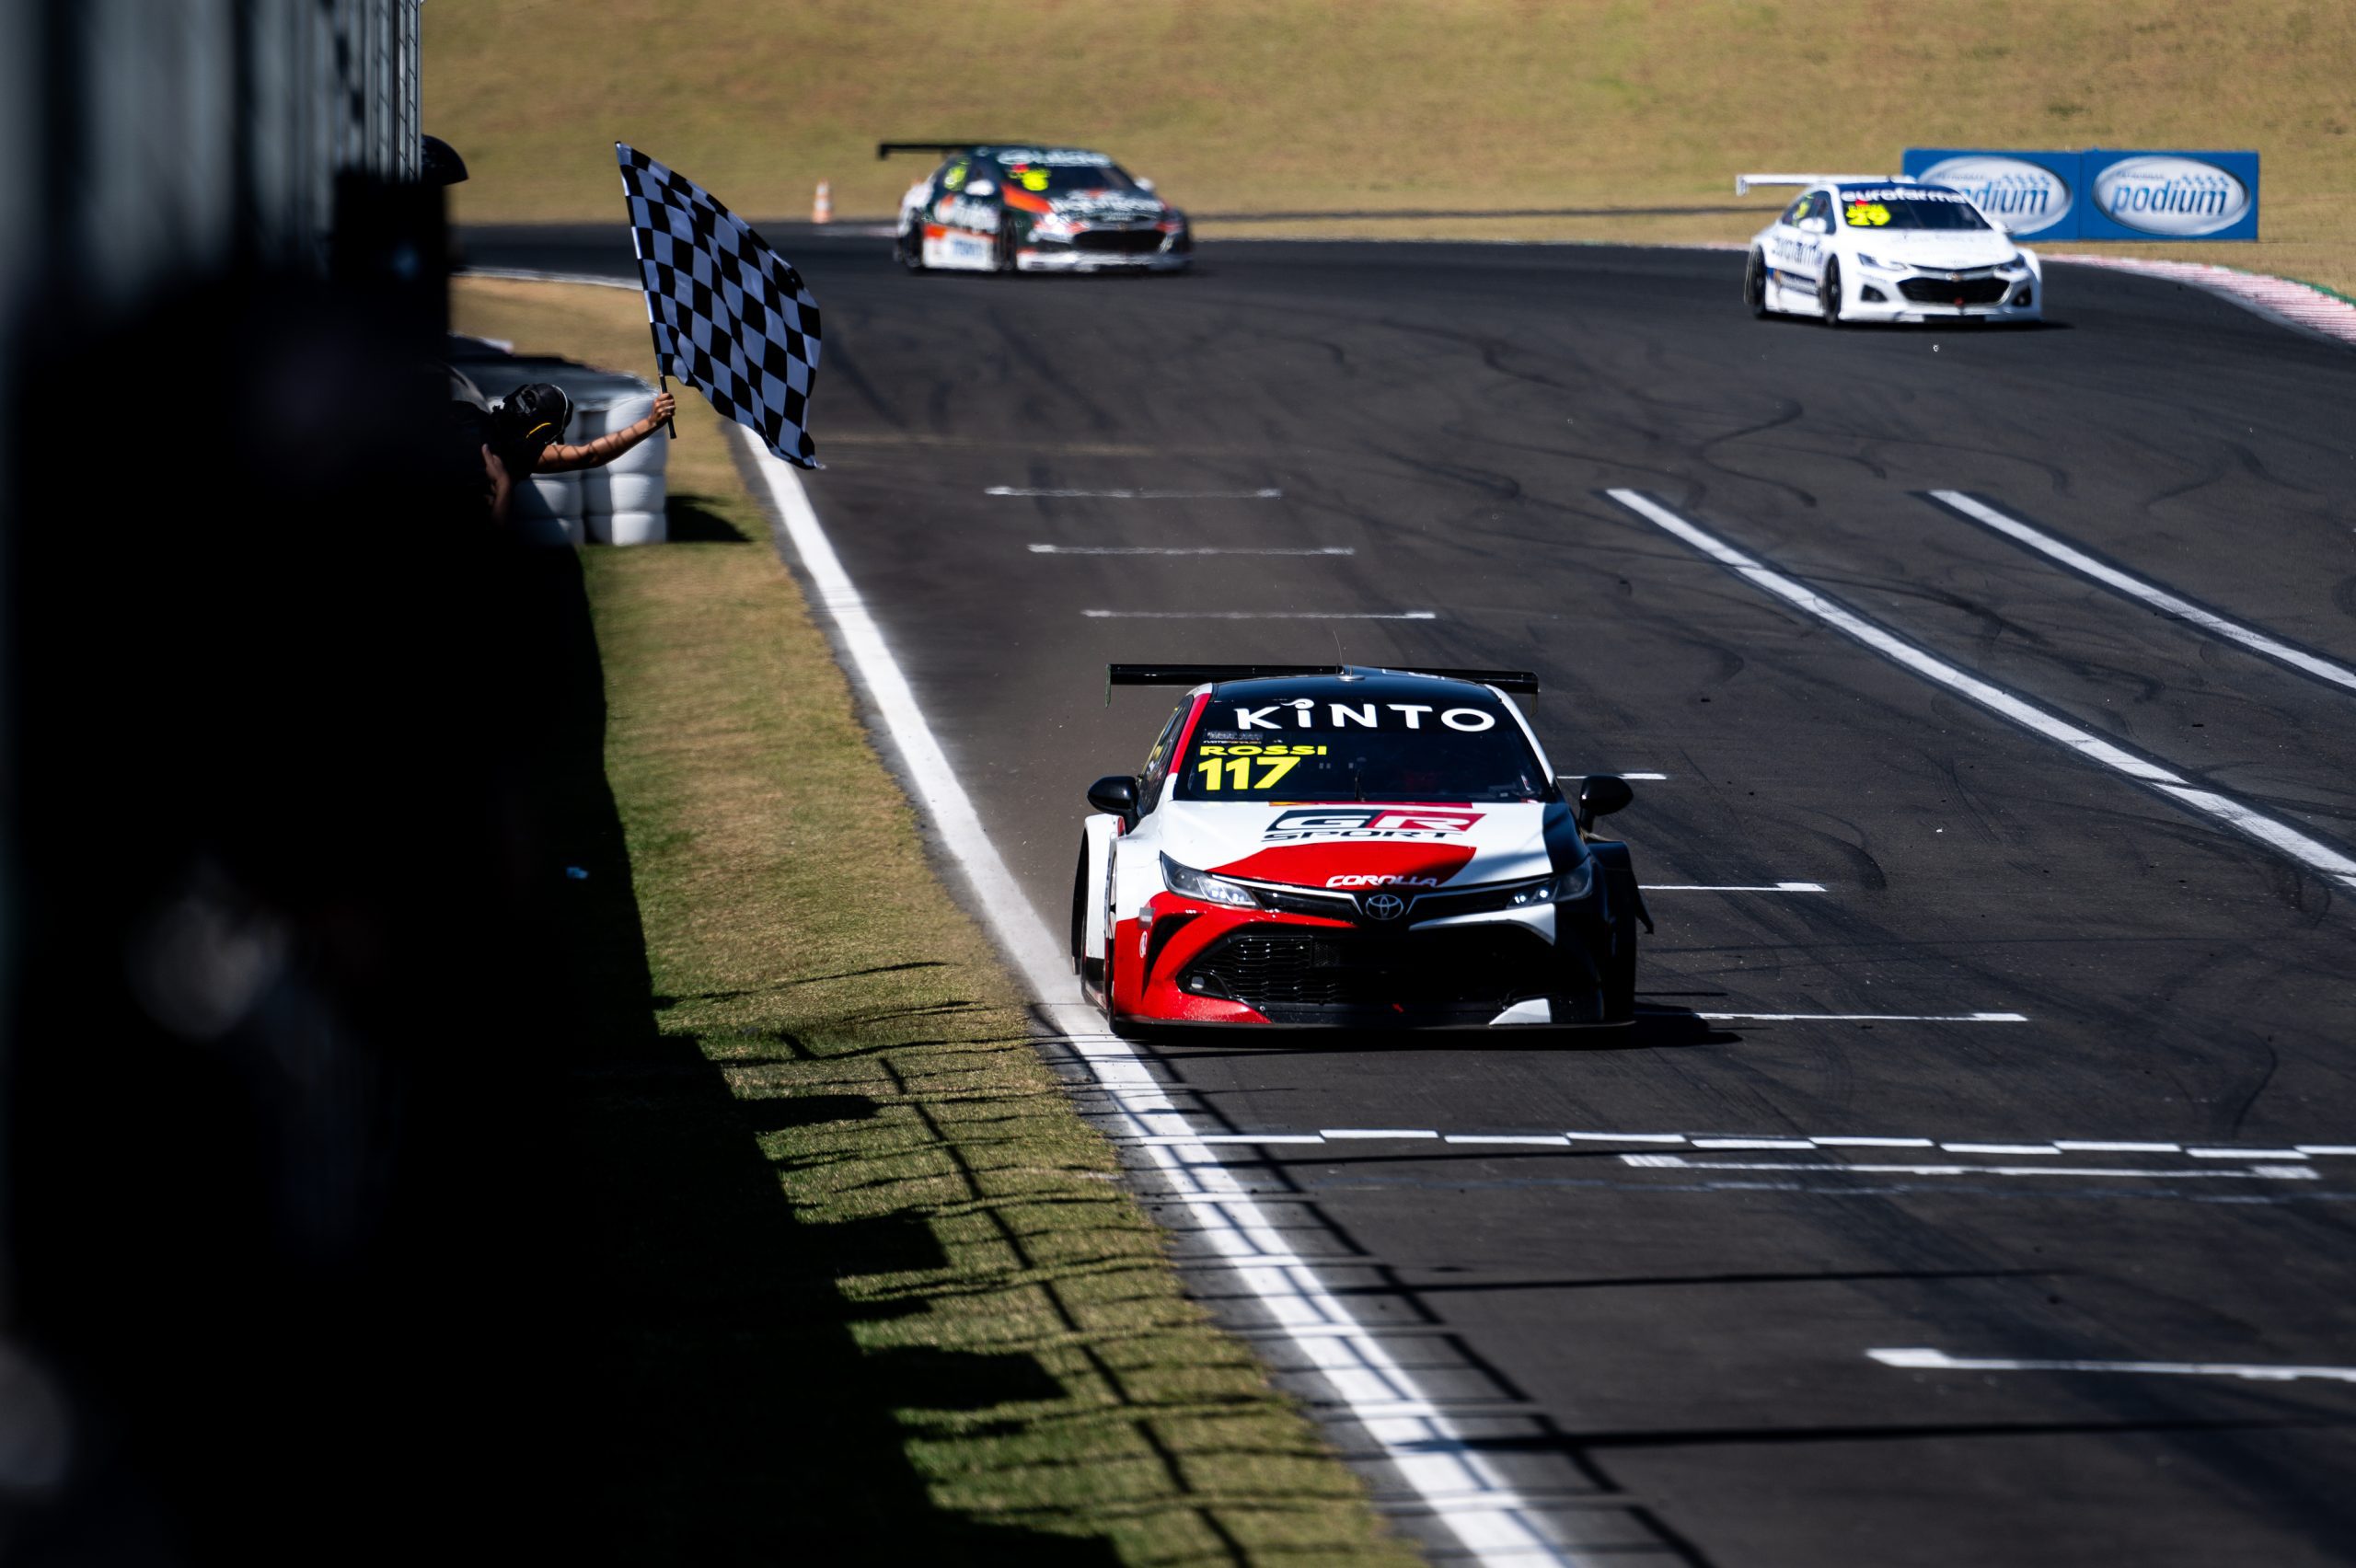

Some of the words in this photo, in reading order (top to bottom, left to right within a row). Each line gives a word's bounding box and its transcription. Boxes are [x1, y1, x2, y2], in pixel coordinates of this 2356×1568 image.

[1841, 187, 1966, 202] eurofarma
[2109, 179, 2227, 215] podium
[1199, 745, 1327, 755] ROSSI
[1198, 756, 1300, 790] 117
[1269, 811, 1478, 832] GR
[1261, 831, 1462, 842] SPORT
[1325, 874, 1438, 888] COROLLA
